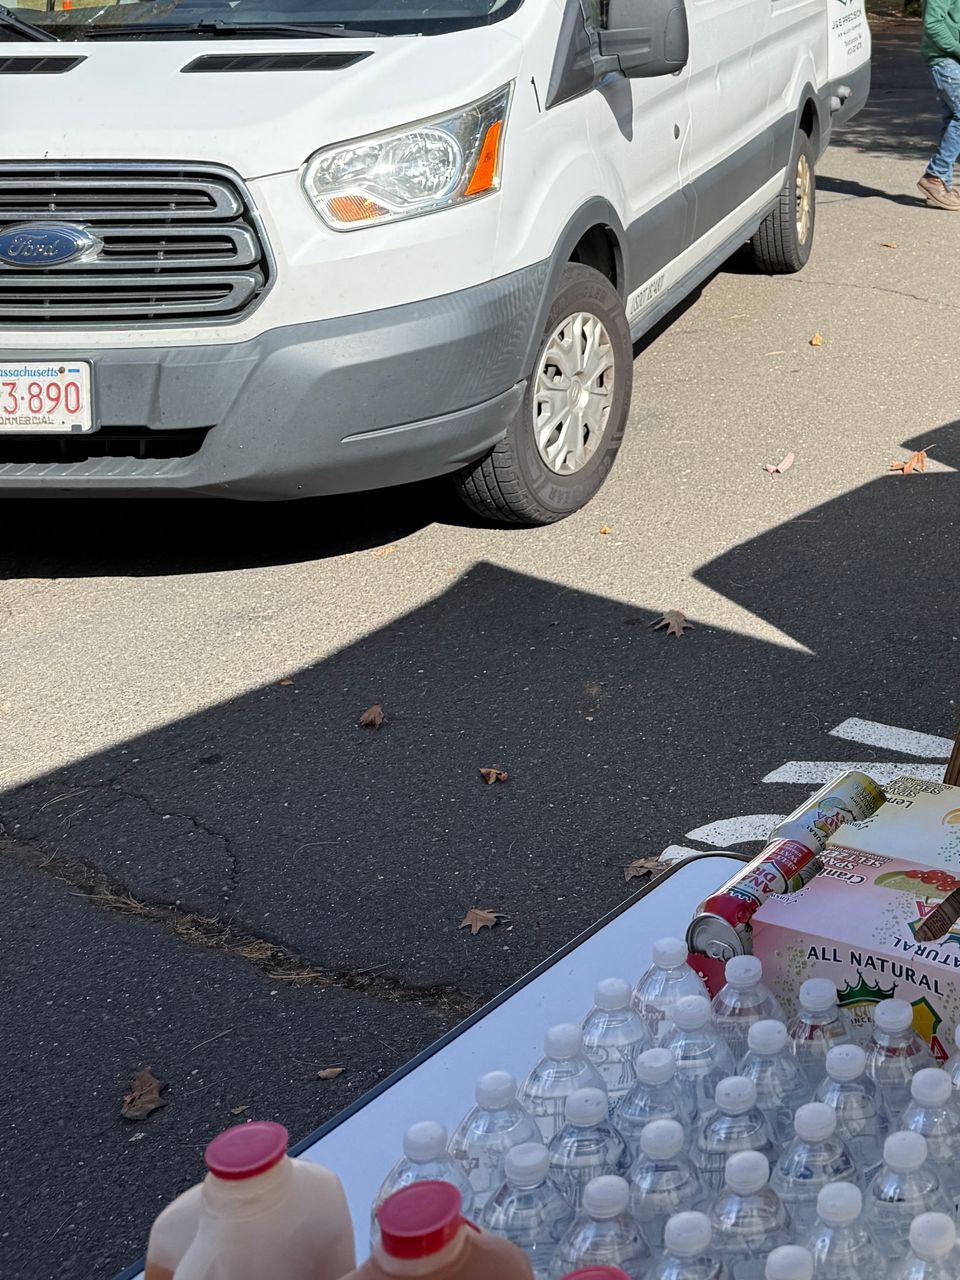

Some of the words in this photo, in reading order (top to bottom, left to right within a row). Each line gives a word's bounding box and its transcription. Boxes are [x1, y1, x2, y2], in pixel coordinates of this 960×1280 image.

[8, 235, 60, 256] Ford
[807, 946, 842, 963] ALL
[850, 951, 944, 997] NATURAL
